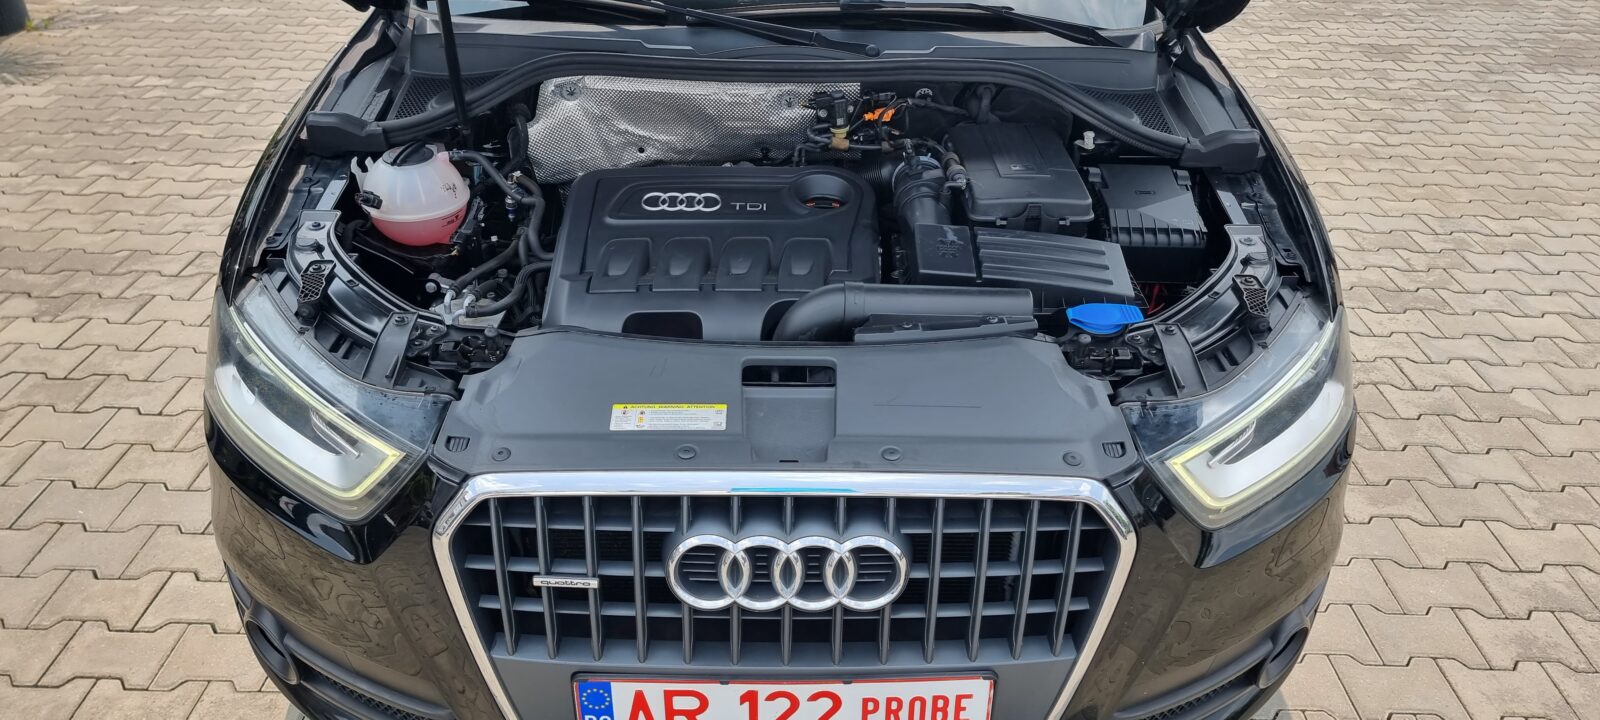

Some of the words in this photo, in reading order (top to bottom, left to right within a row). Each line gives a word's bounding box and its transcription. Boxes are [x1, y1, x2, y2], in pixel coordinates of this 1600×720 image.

[730, 202, 767, 211] TDI
[628, 689, 709, 720] AR
[739, 689, 842, 720] 122
[861, 693, 973, 720] PROBE
